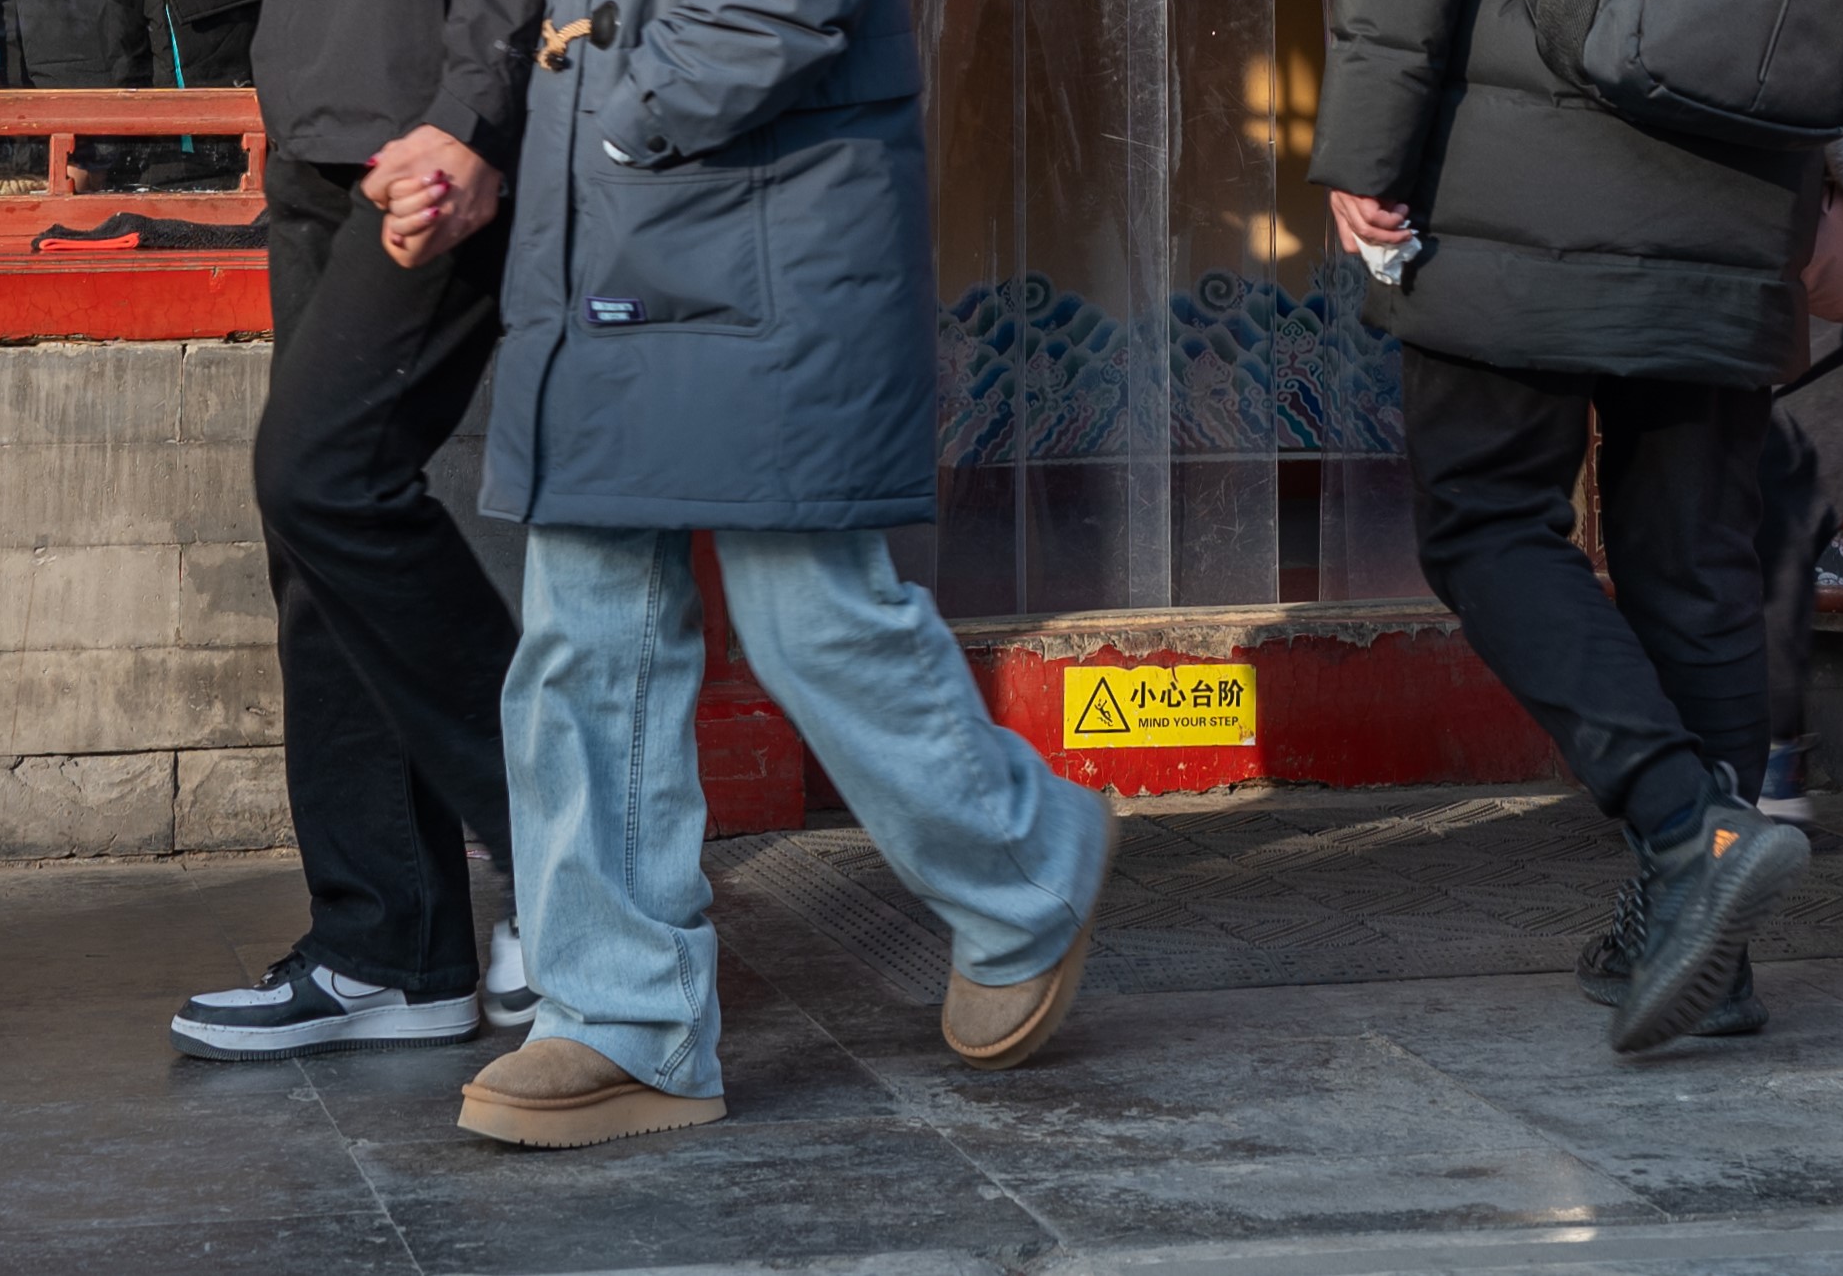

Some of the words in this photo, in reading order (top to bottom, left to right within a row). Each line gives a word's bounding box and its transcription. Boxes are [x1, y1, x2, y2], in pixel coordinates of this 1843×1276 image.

[1130, 679, 1245, 709] 小心台阶
[1138, 716, 1170, 729] MIND
[1173, 716, 1207, 729] YOUR
[1209, 715, 1239, 727] STEP
